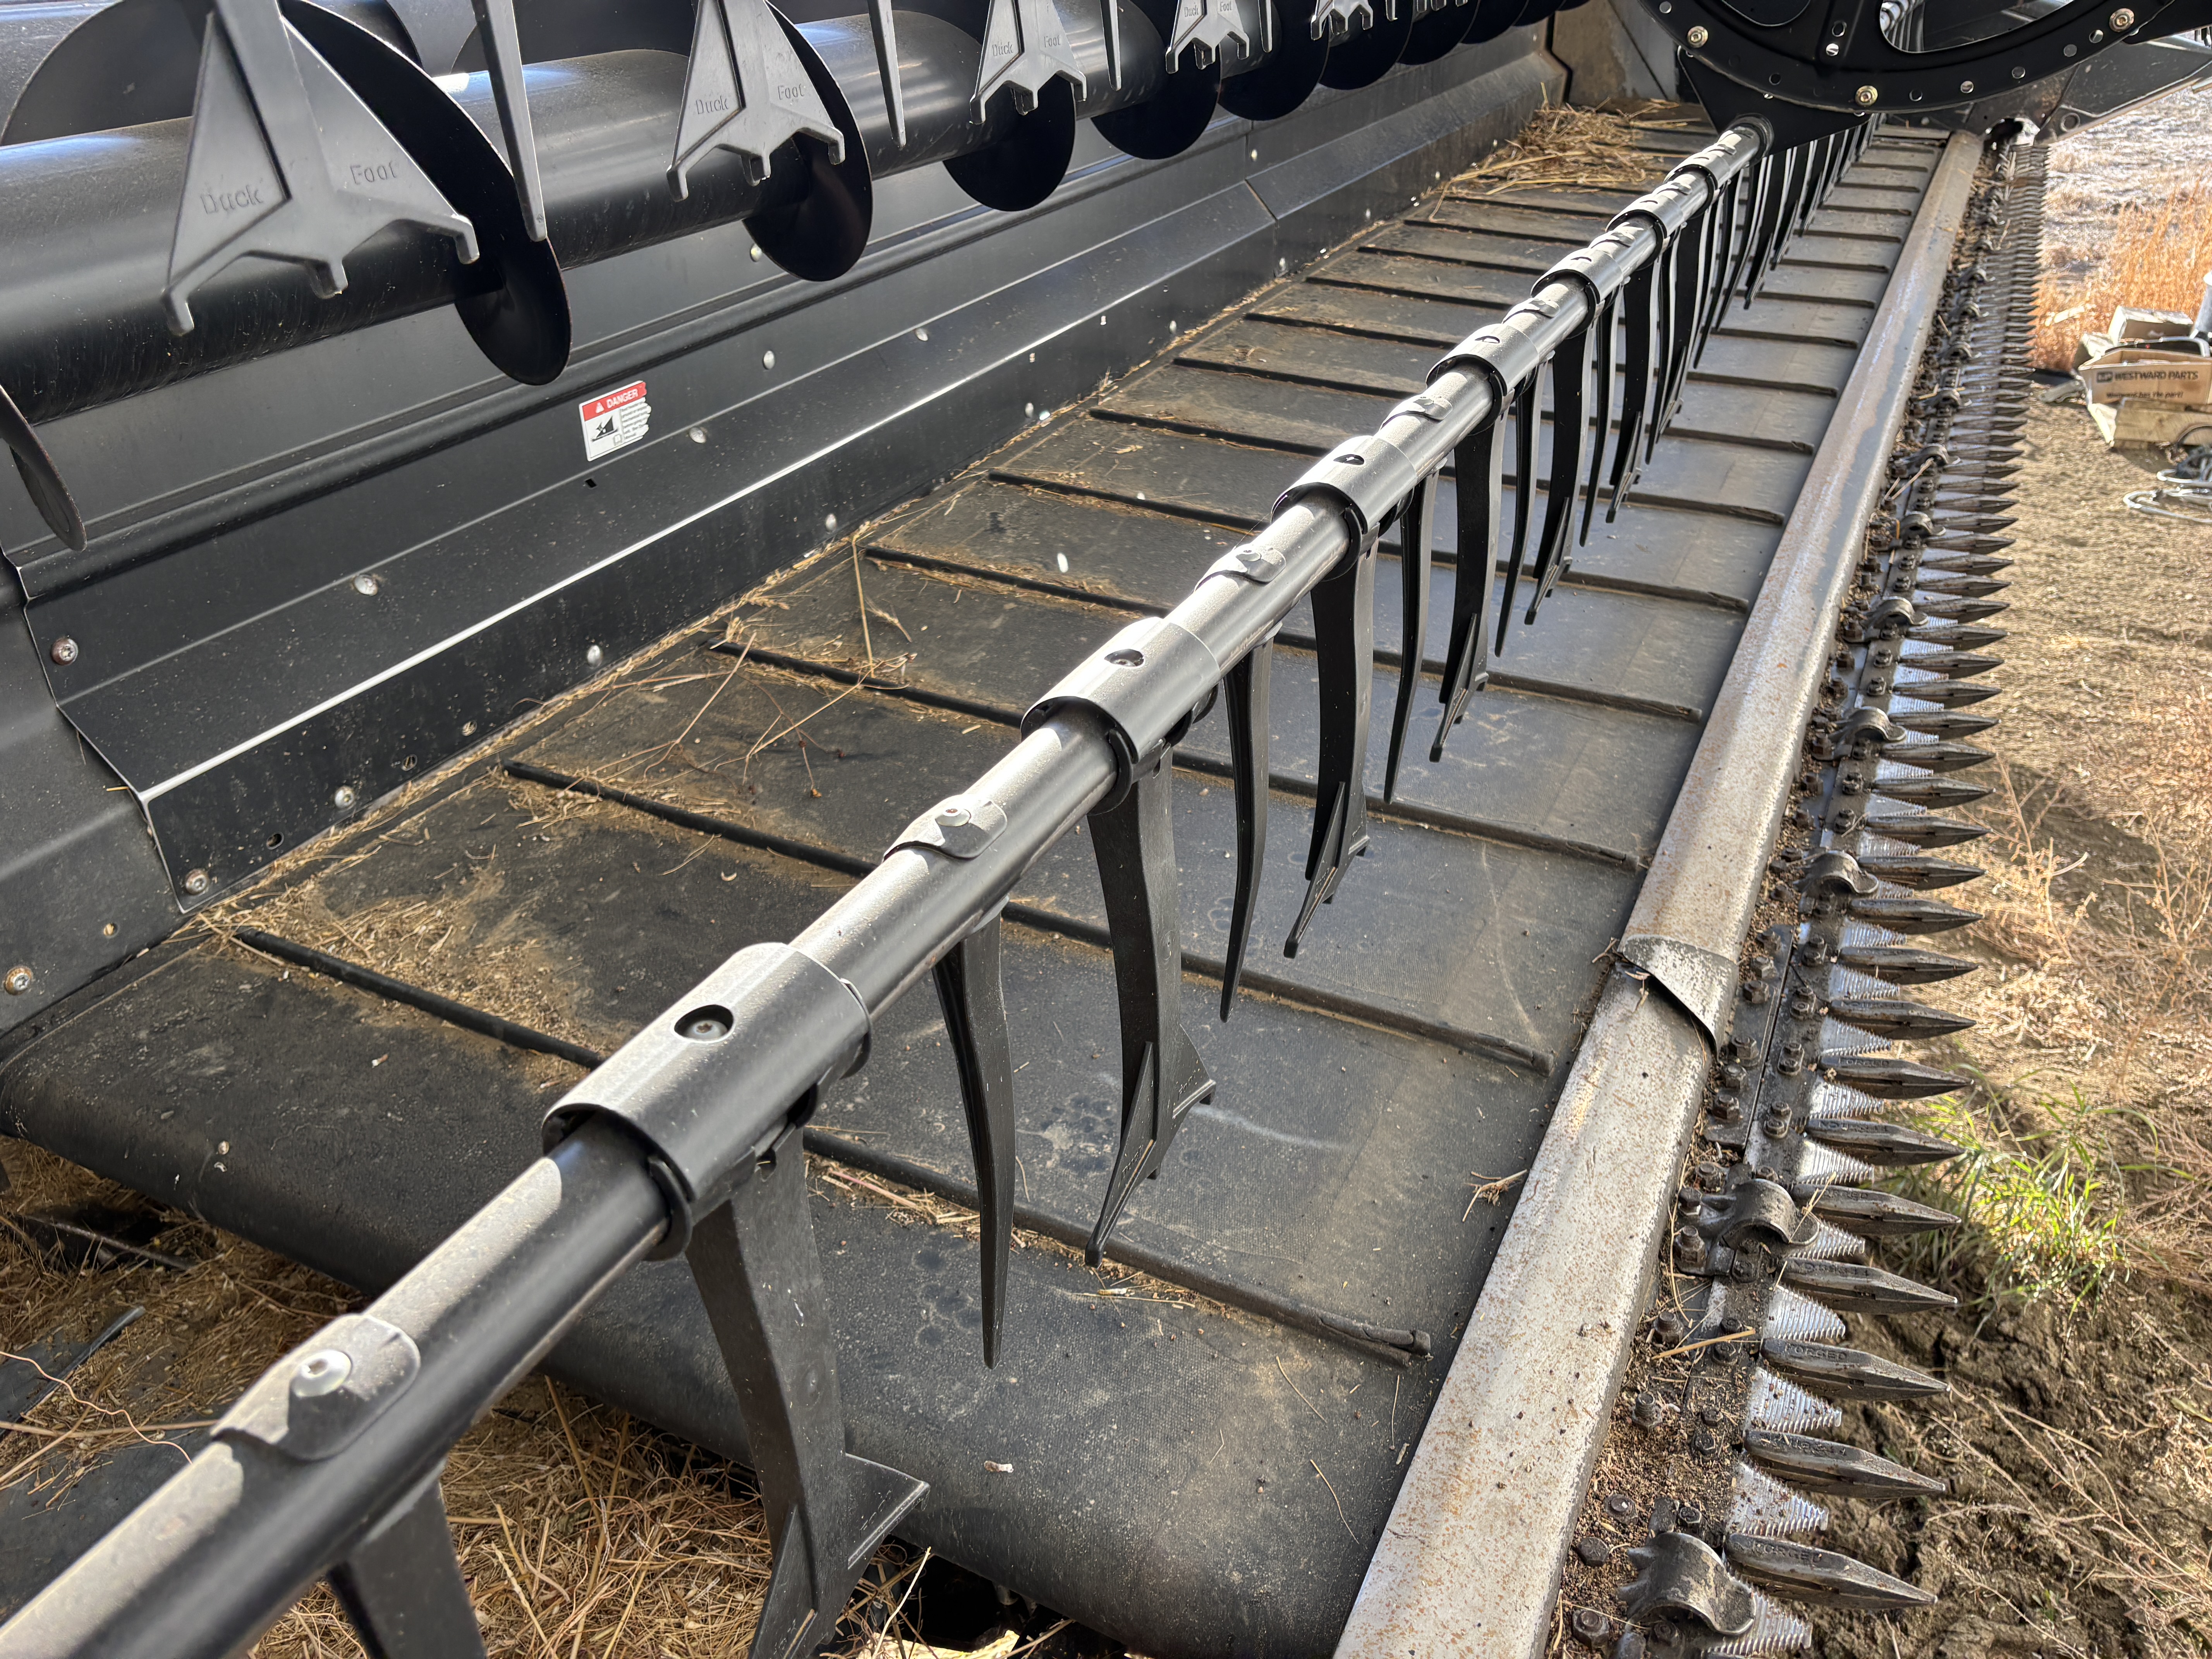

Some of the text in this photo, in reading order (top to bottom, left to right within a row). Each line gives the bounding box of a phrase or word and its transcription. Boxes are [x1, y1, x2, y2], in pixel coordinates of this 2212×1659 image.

[992, 35, 1061, 56] Duck Foot
[696, 84, 804, 114] Duck Foot
[200, 161, 397, 214] Duck Foot
[2115, 371, 2167, 380] WESTWARD
[2169, 371, 2198, 380] PARTS
[606, 388, 638, 408] DANGER
[1785, 1342, 1847, 1362] FORGED
